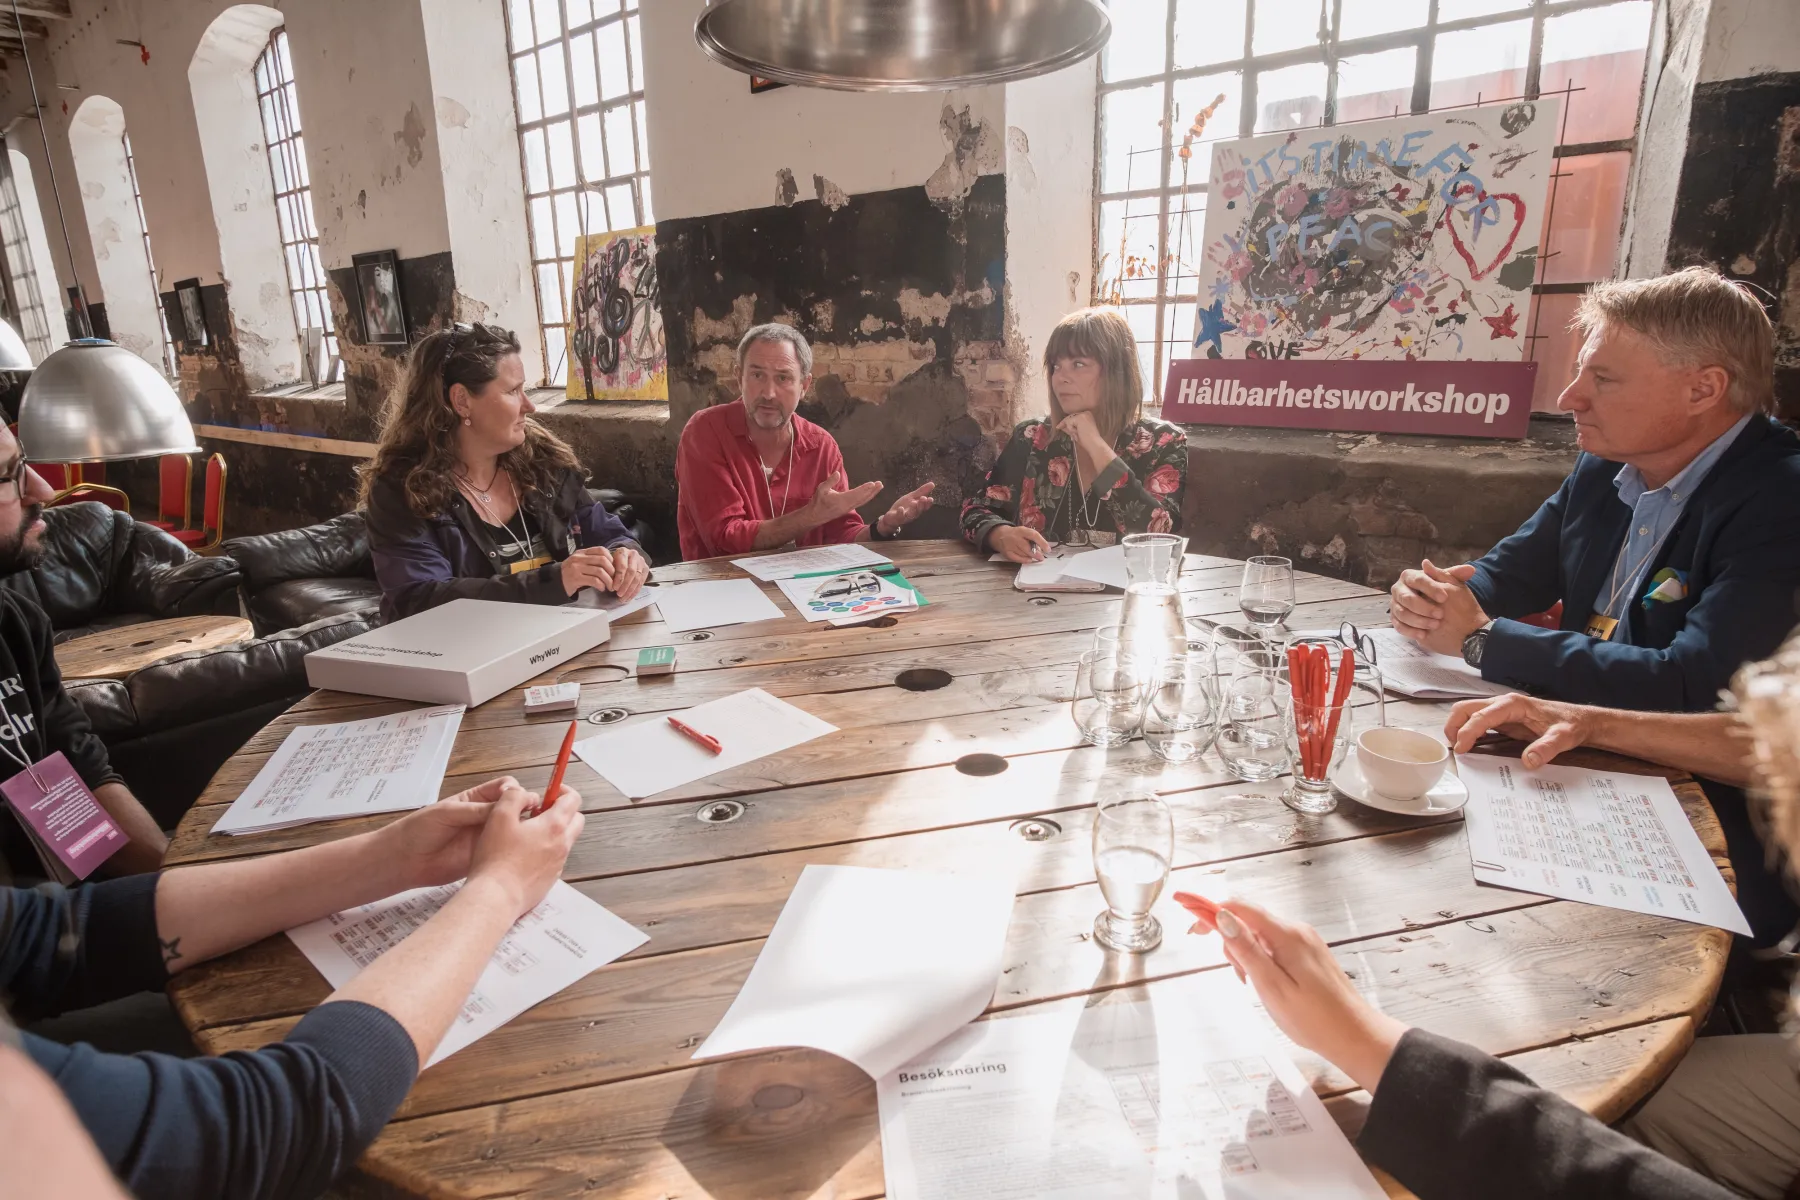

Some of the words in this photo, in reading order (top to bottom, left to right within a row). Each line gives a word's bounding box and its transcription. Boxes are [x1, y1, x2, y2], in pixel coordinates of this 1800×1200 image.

[1177, 376, 1511, 424] Hållbarhetsworkshop
[529, 646, 560, 665] WhyWay
[898, 1062, 1007, 1084] Besöksnäring
